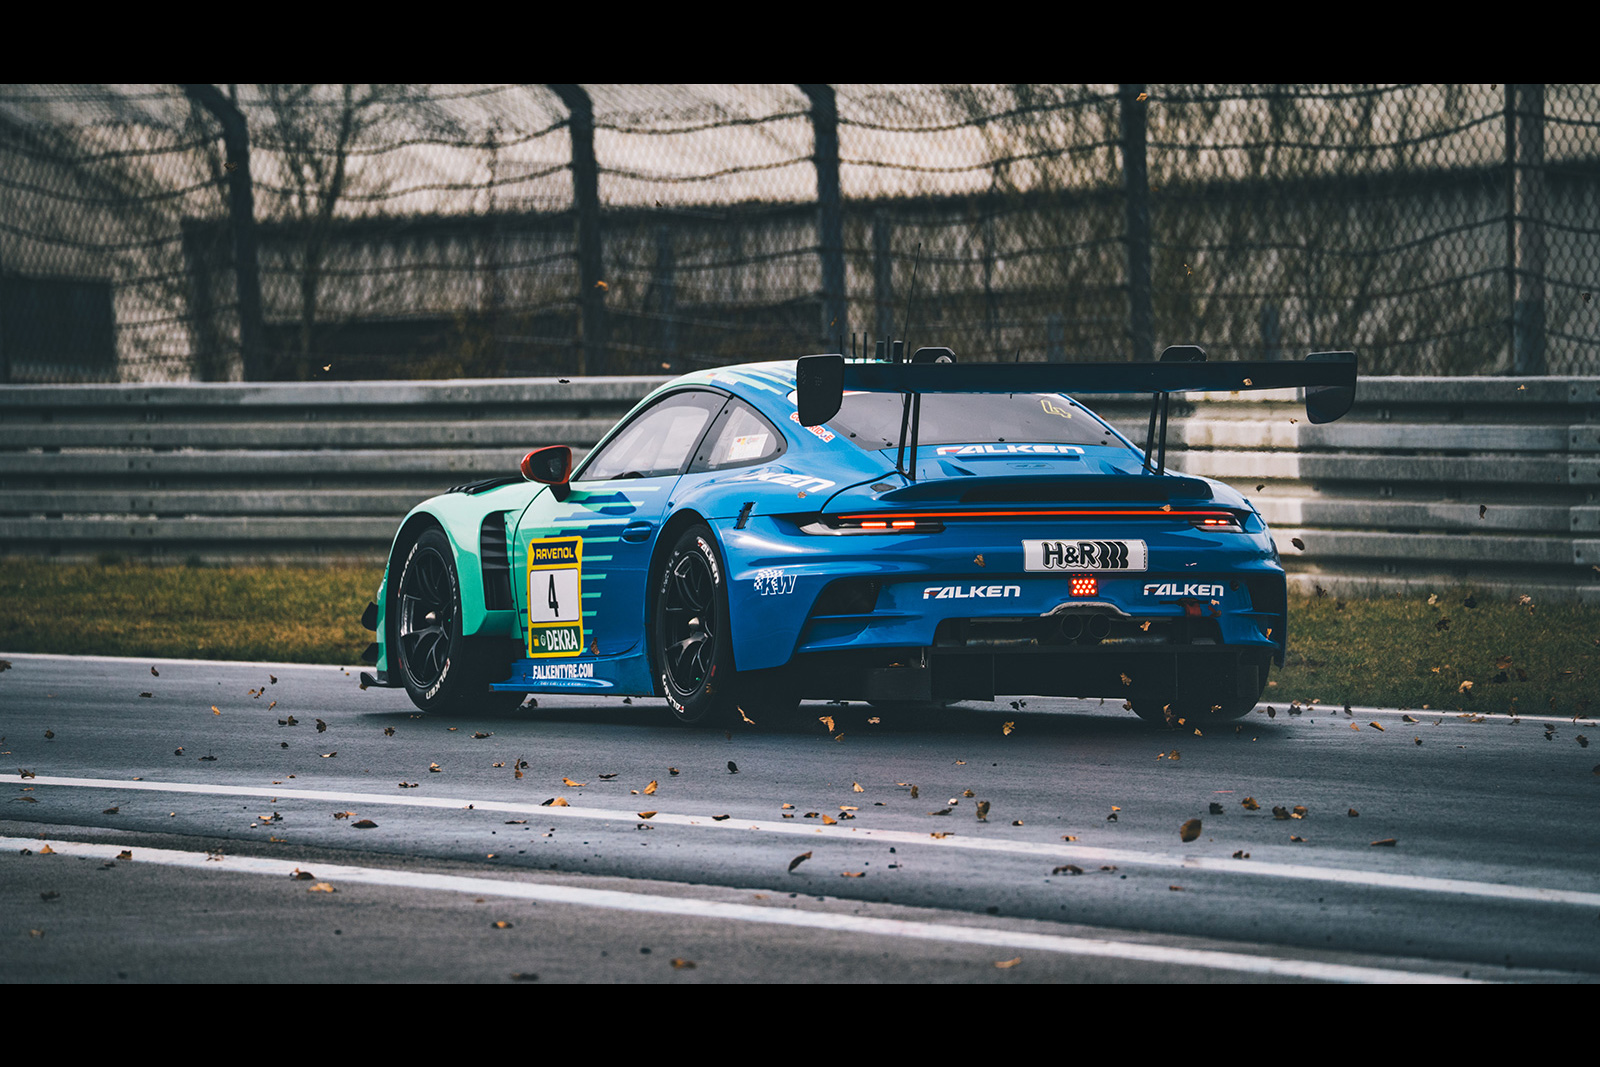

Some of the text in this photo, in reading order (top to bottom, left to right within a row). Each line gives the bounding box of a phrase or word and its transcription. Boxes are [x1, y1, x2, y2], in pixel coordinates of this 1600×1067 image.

[1040, 399, 1072, 419] 4
[936, 445, 1085, 456] FALKEN
[536, 547, 574, 560] RAVENOL
[696, 536, 720, 585] FALKEN
[1042, 542, 1101, 569] H&R
[760, 574, 797, 596] KW
[923, 585, 1021, 600] FALKEN
[1144, 583, 1224, 597] FALKEN
[548, 574, 559, 618] 4
[545, 629, 579, 651] DEKRA
[532, 663, 594, 680] FALKENTYRE.COM
